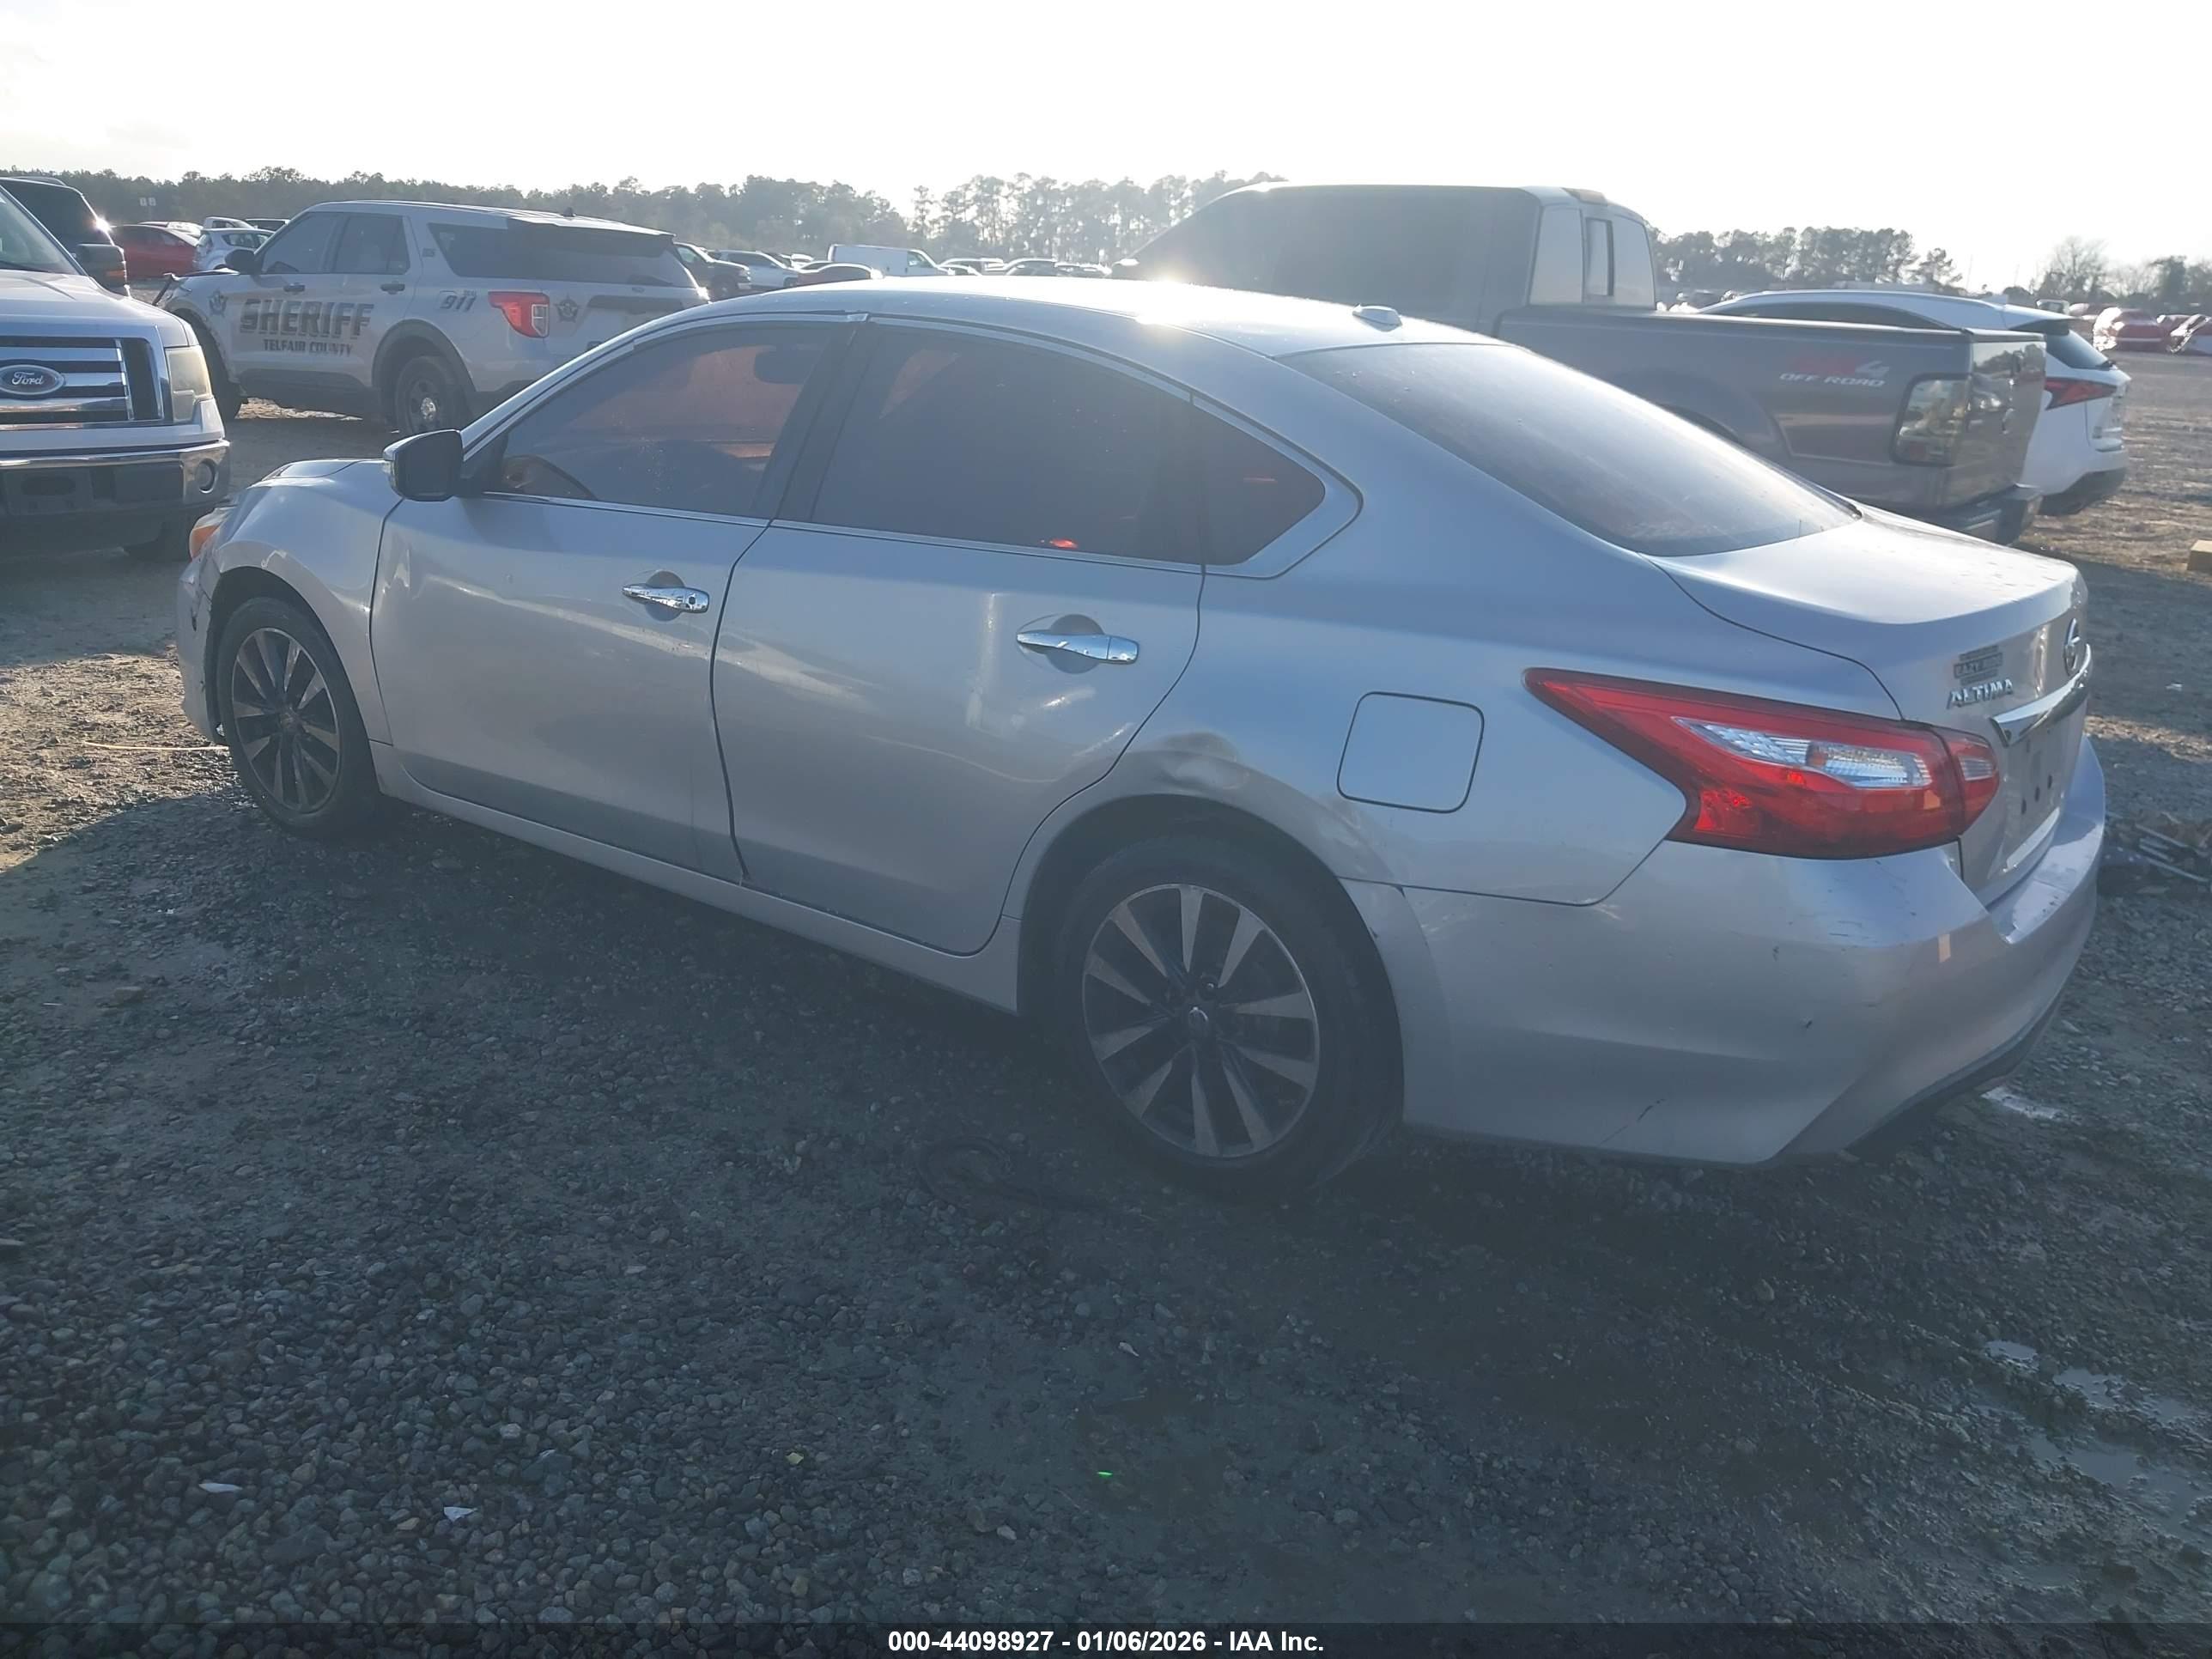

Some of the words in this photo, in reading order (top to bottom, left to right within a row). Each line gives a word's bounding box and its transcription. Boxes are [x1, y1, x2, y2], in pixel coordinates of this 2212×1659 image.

[439, 295, 477, 312] 911
[240, 298, 374, 340] SHERIFF
[263, 338, 306, 352] TELFAIR
[309, 341, 353, 357] COUNTY
[11, 371, 44, 385] Ford
[1779, 373, 1819, 382] OFF
[1824, 375, 1886, 386] ROAD
[1947, 678, 2014, 708] ALTIMA
